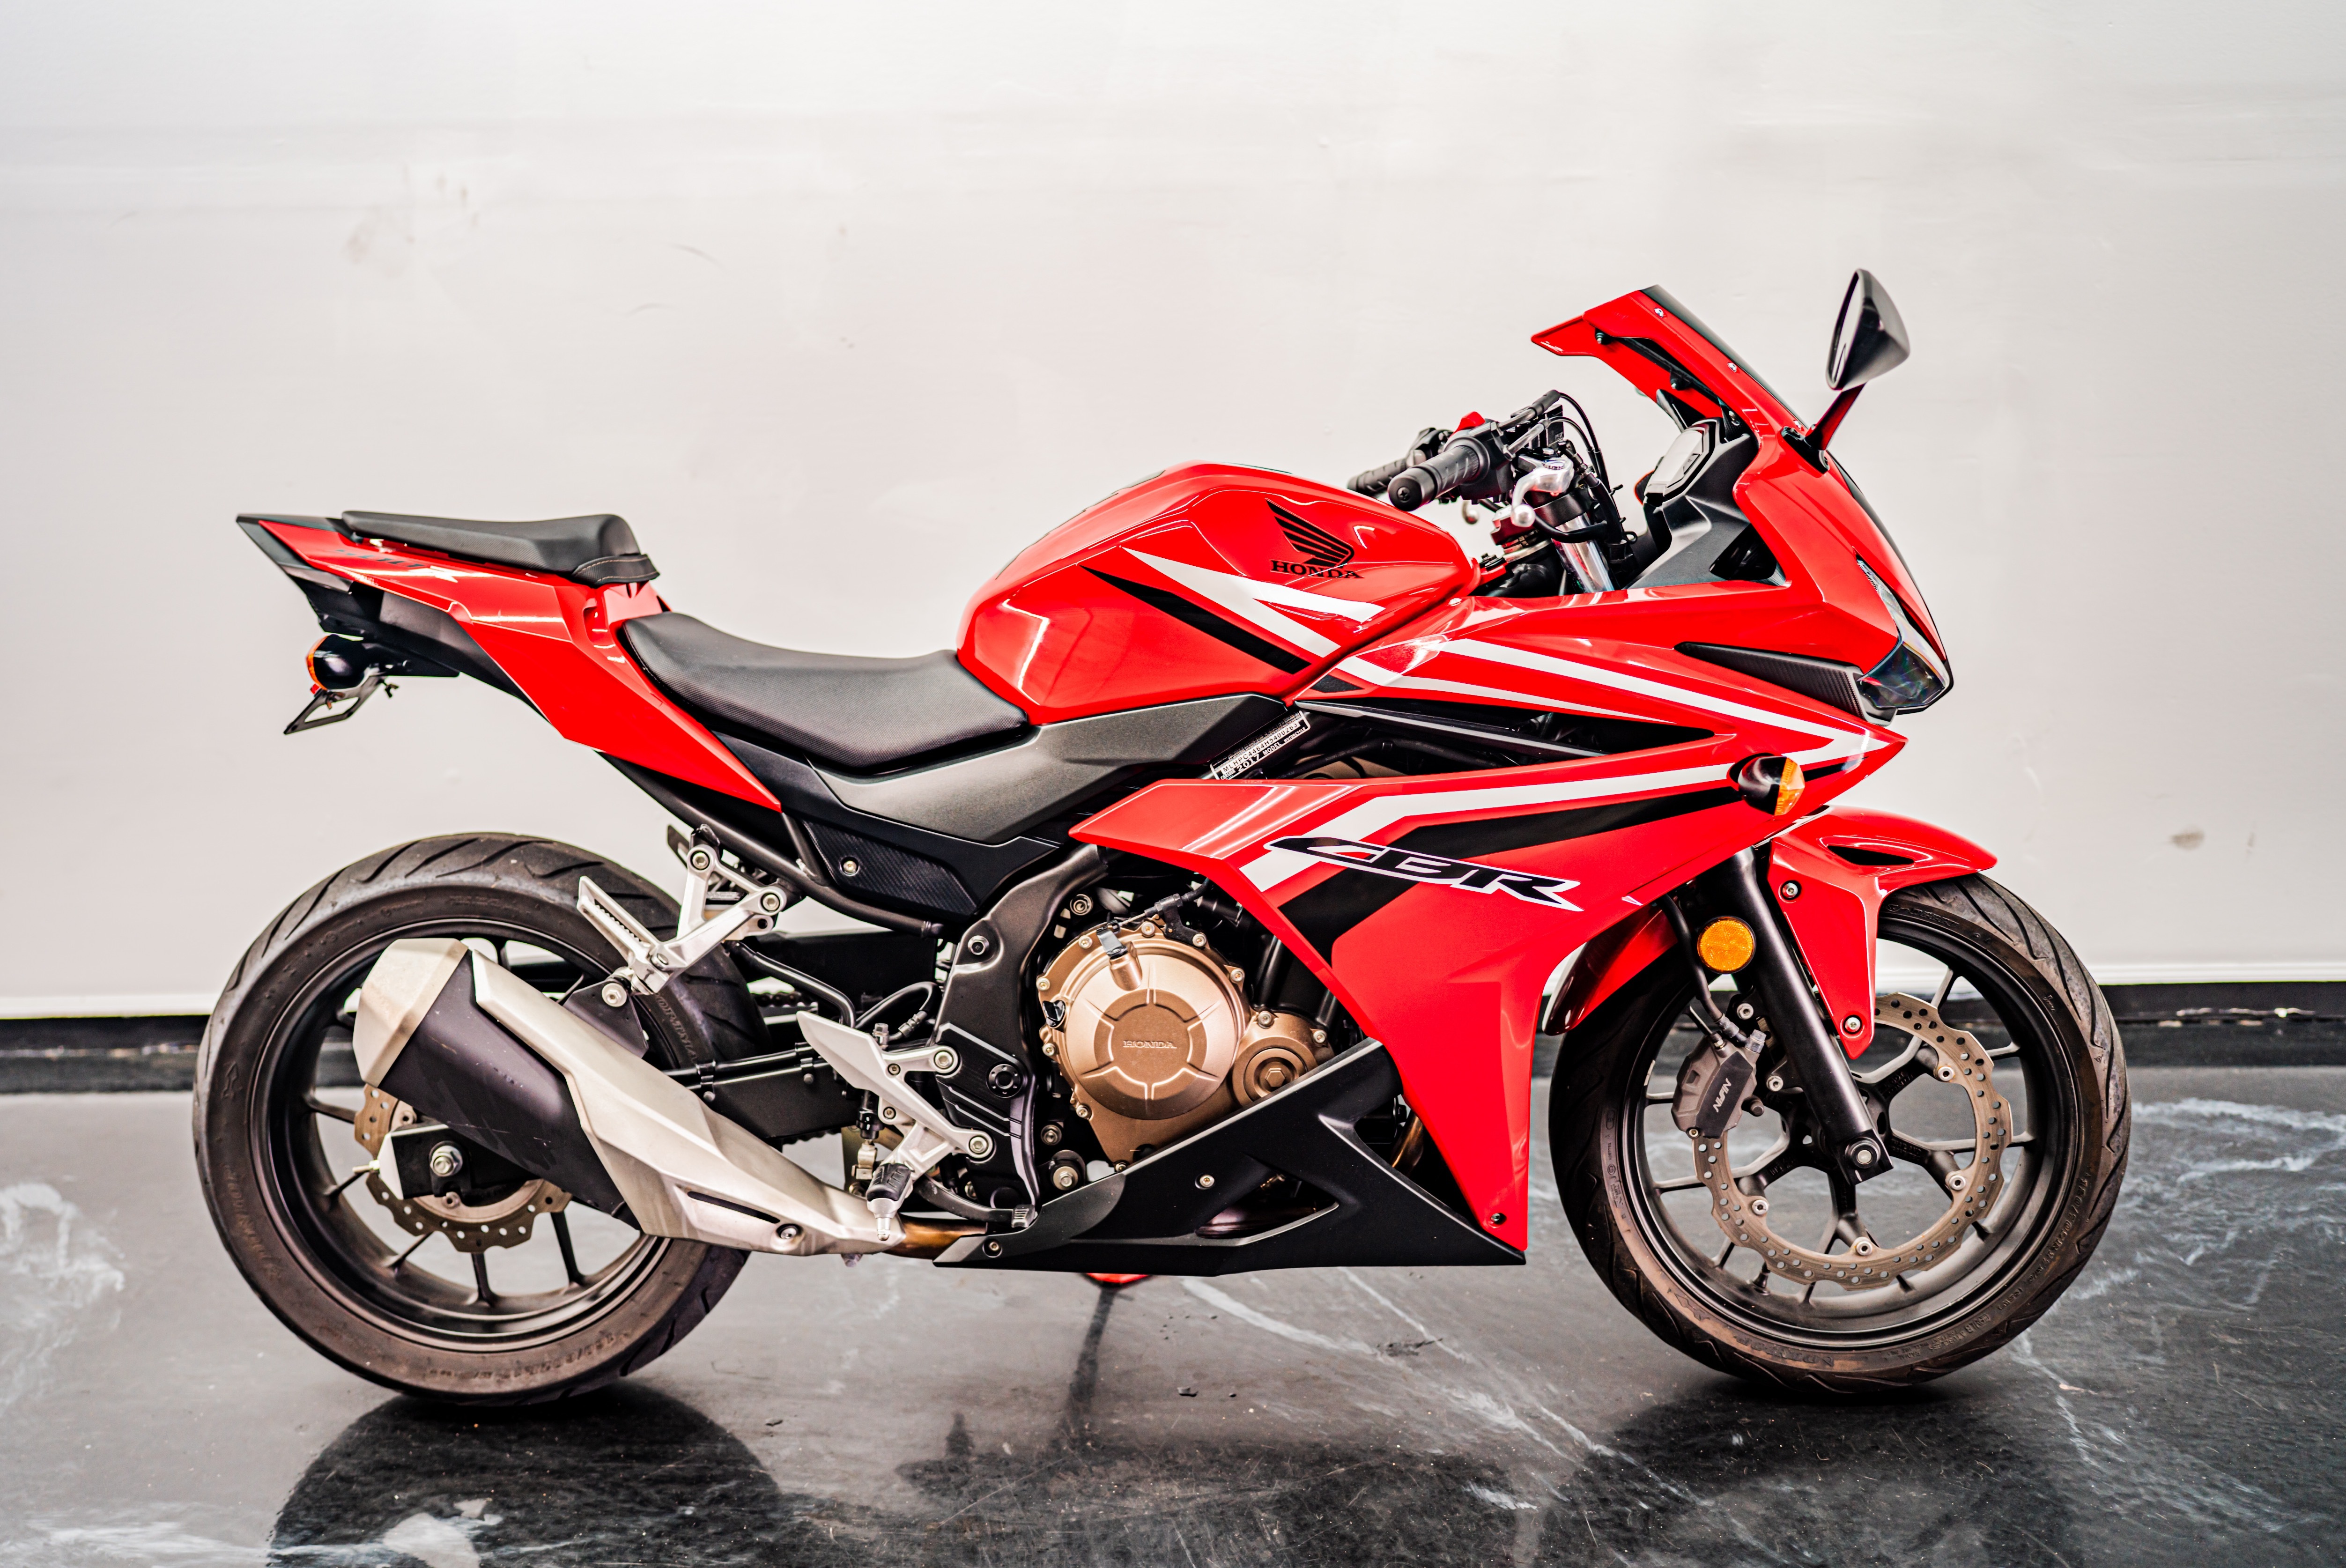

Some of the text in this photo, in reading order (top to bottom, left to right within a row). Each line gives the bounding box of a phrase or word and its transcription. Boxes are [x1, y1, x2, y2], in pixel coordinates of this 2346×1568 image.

[1270, 560, 1363, 578] HONDA
[1223, 723, 1298, 771] MLHPC4464H5400263
[1237, 754, 1260, 772] 2017
[1263, 742, 1282, 756] MODEL
[1283, 727, 1306, 742] MOTORCYCLE
[1264, 836, 1584, 911] CBR
[1123, 1039, 1177, 1049] HONDA
